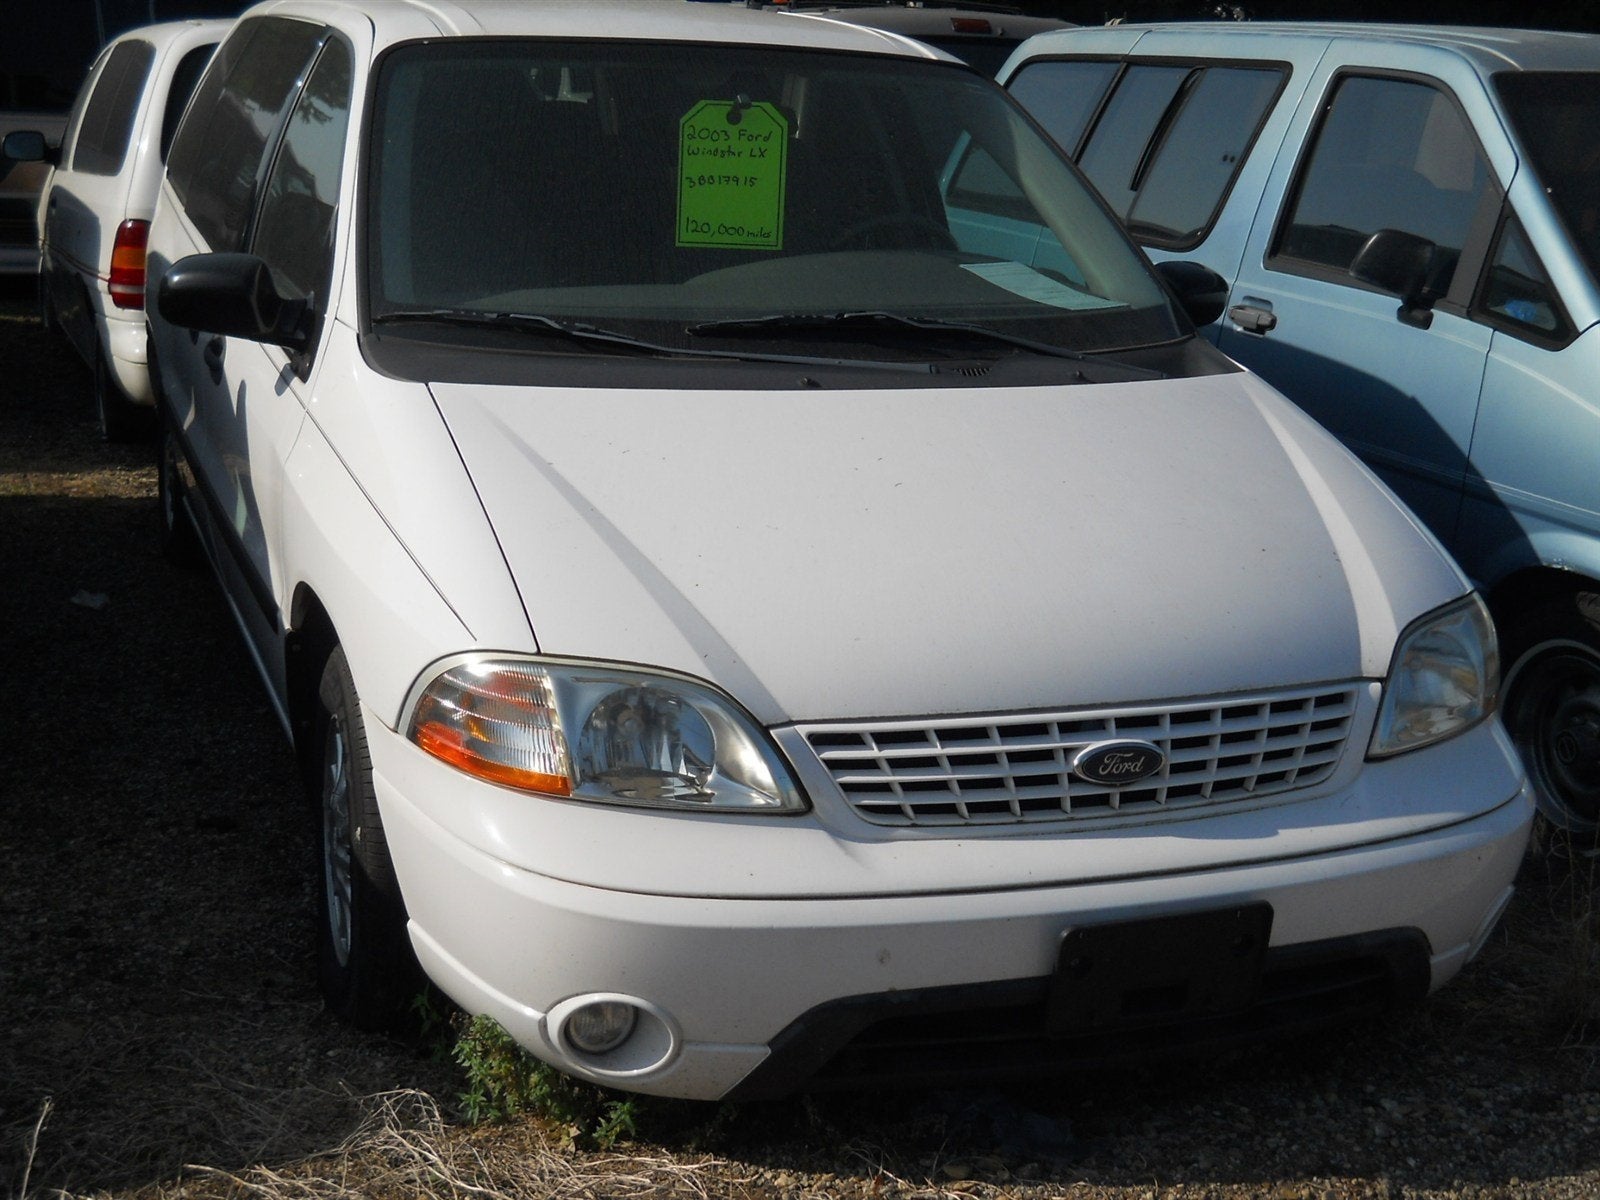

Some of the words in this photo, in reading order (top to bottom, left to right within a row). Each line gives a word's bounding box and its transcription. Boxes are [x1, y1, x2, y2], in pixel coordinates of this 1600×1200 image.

[687, 125, 730, 142] 2003
[738, 129, 773, 142] Ford
[750, 148, 767, 158] LX
[685, 216, 745, 237] 120,000
[747, 226, 772, 239] miles
[1099, 752, 1145, 775] Ford
